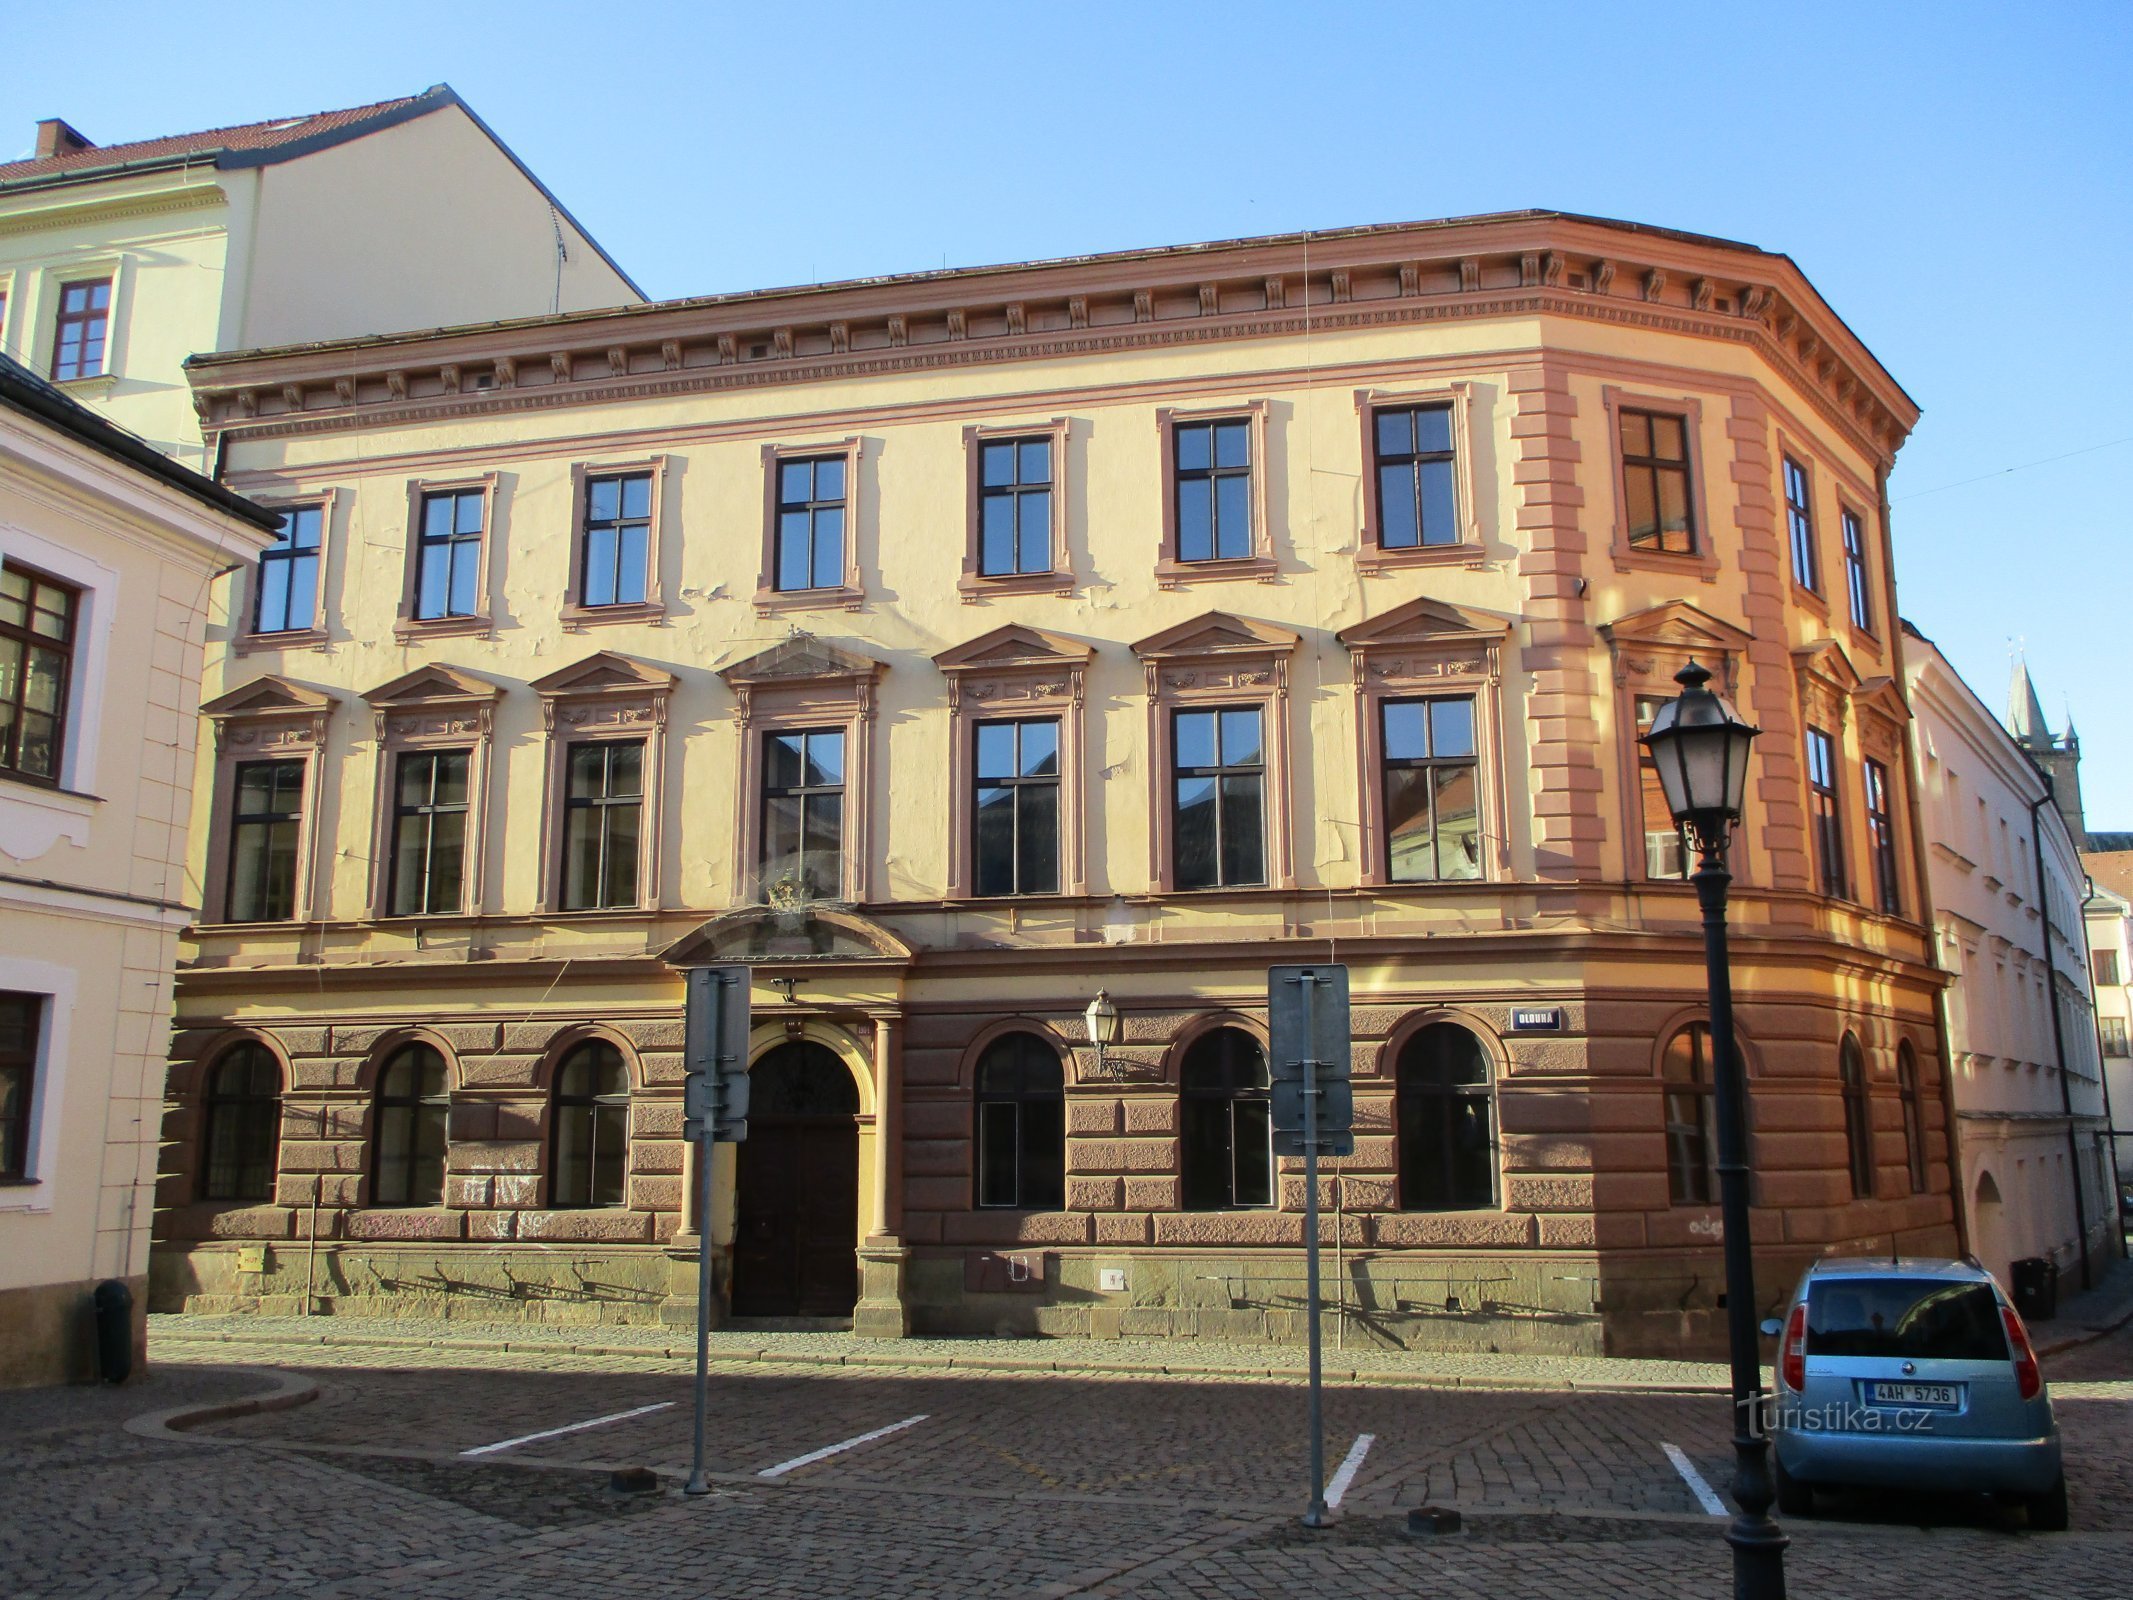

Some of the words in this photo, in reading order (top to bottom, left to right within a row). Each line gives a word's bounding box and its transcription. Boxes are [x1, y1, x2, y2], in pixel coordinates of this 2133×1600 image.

[1518, 1011, 1554, 1024] DLOUHÁ
[1878, 1384, 1905, 1401] 4AH
[1914, 1386, 1951, 1402] 5736
